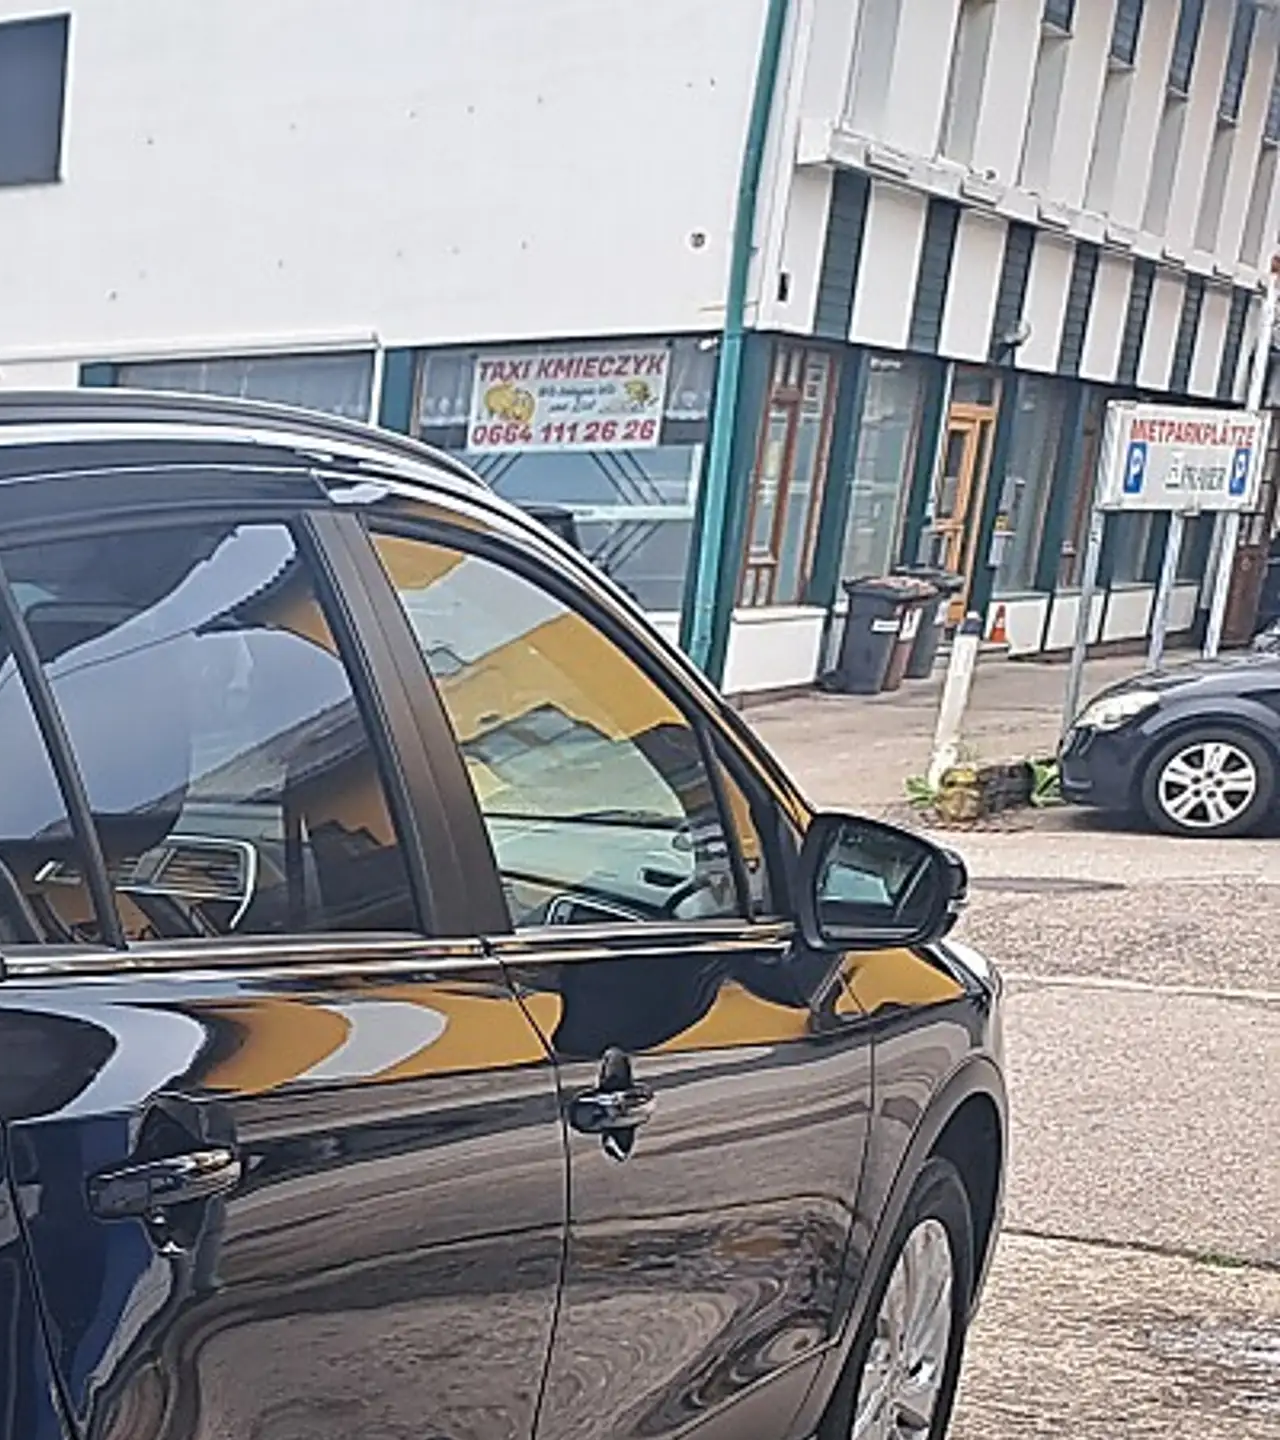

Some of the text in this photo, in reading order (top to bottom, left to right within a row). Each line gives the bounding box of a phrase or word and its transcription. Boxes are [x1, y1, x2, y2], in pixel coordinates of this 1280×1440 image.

[478, 354, 665, 382] TAXI KMIECZYK
[472, 418, 656, 446] 0664 111 26 26
[1130, 418, 1255, 446] MIETPARKPLÄTZE
